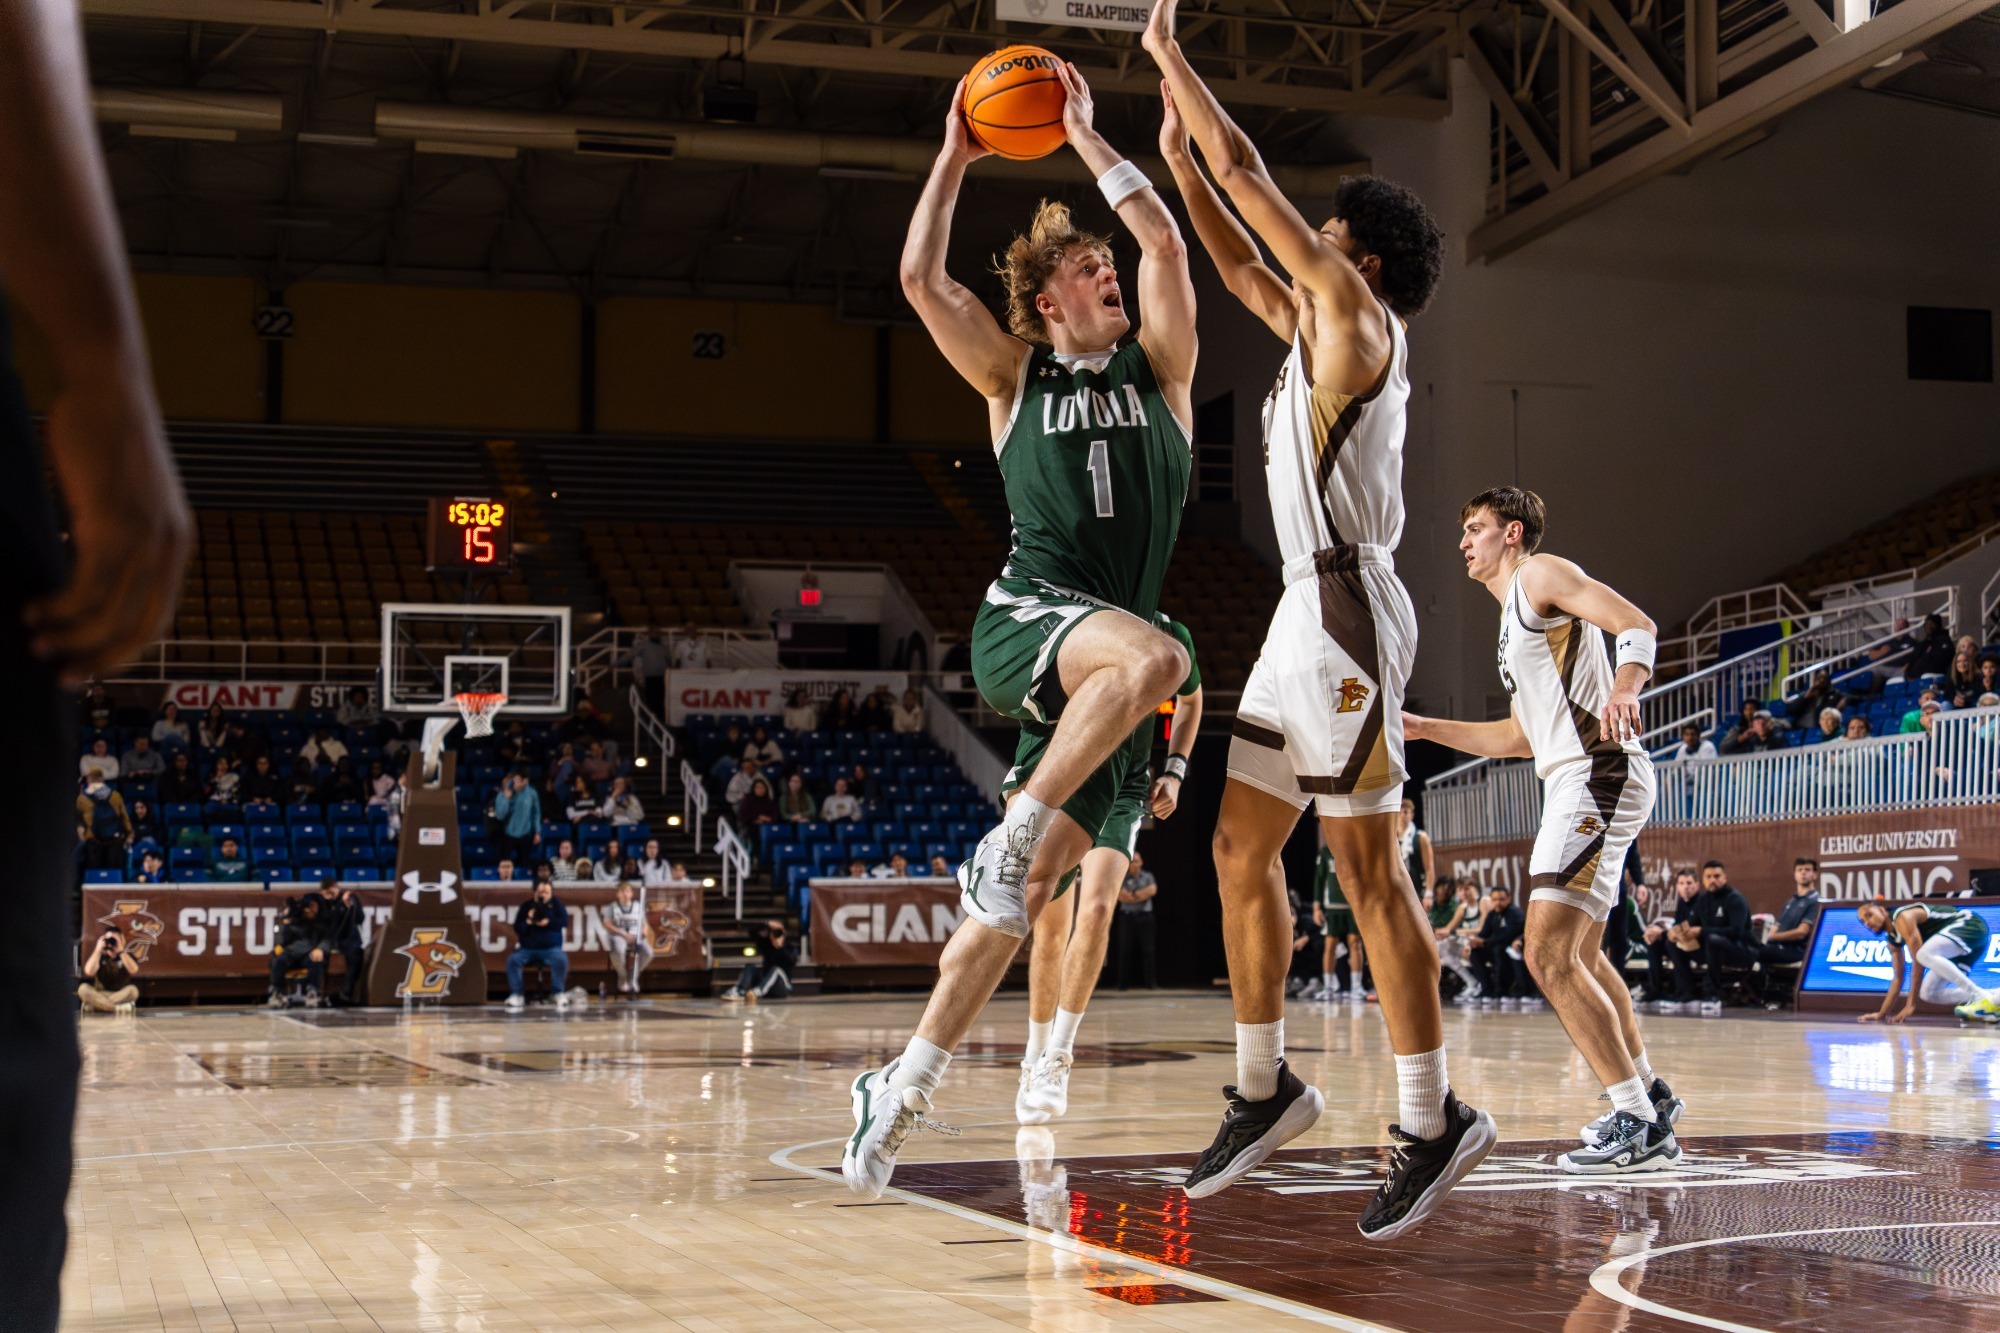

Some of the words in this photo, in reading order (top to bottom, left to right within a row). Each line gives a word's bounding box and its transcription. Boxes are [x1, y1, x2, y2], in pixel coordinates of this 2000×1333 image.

[1066, 2, 1149, 23] CHAMPIONS
[986, 54, 1060, 80] Wilson
[258, 310, 293, 337] 22
[693, 332, 725, 359] 23
[1042, 383, 1148, 436] LOYOLA
[1086, 440, 1114, 518] 1
[448, 502, 504, 526] 15:02
[465, 526, 494, 562] 15
[175, 683, 284, 707] GIANT
[681, 688, 772, 709] GIANT
[1820, 833, 1873, 855] LEHIGH
[1875, 829, 1957, 852] UNIVERSITY
